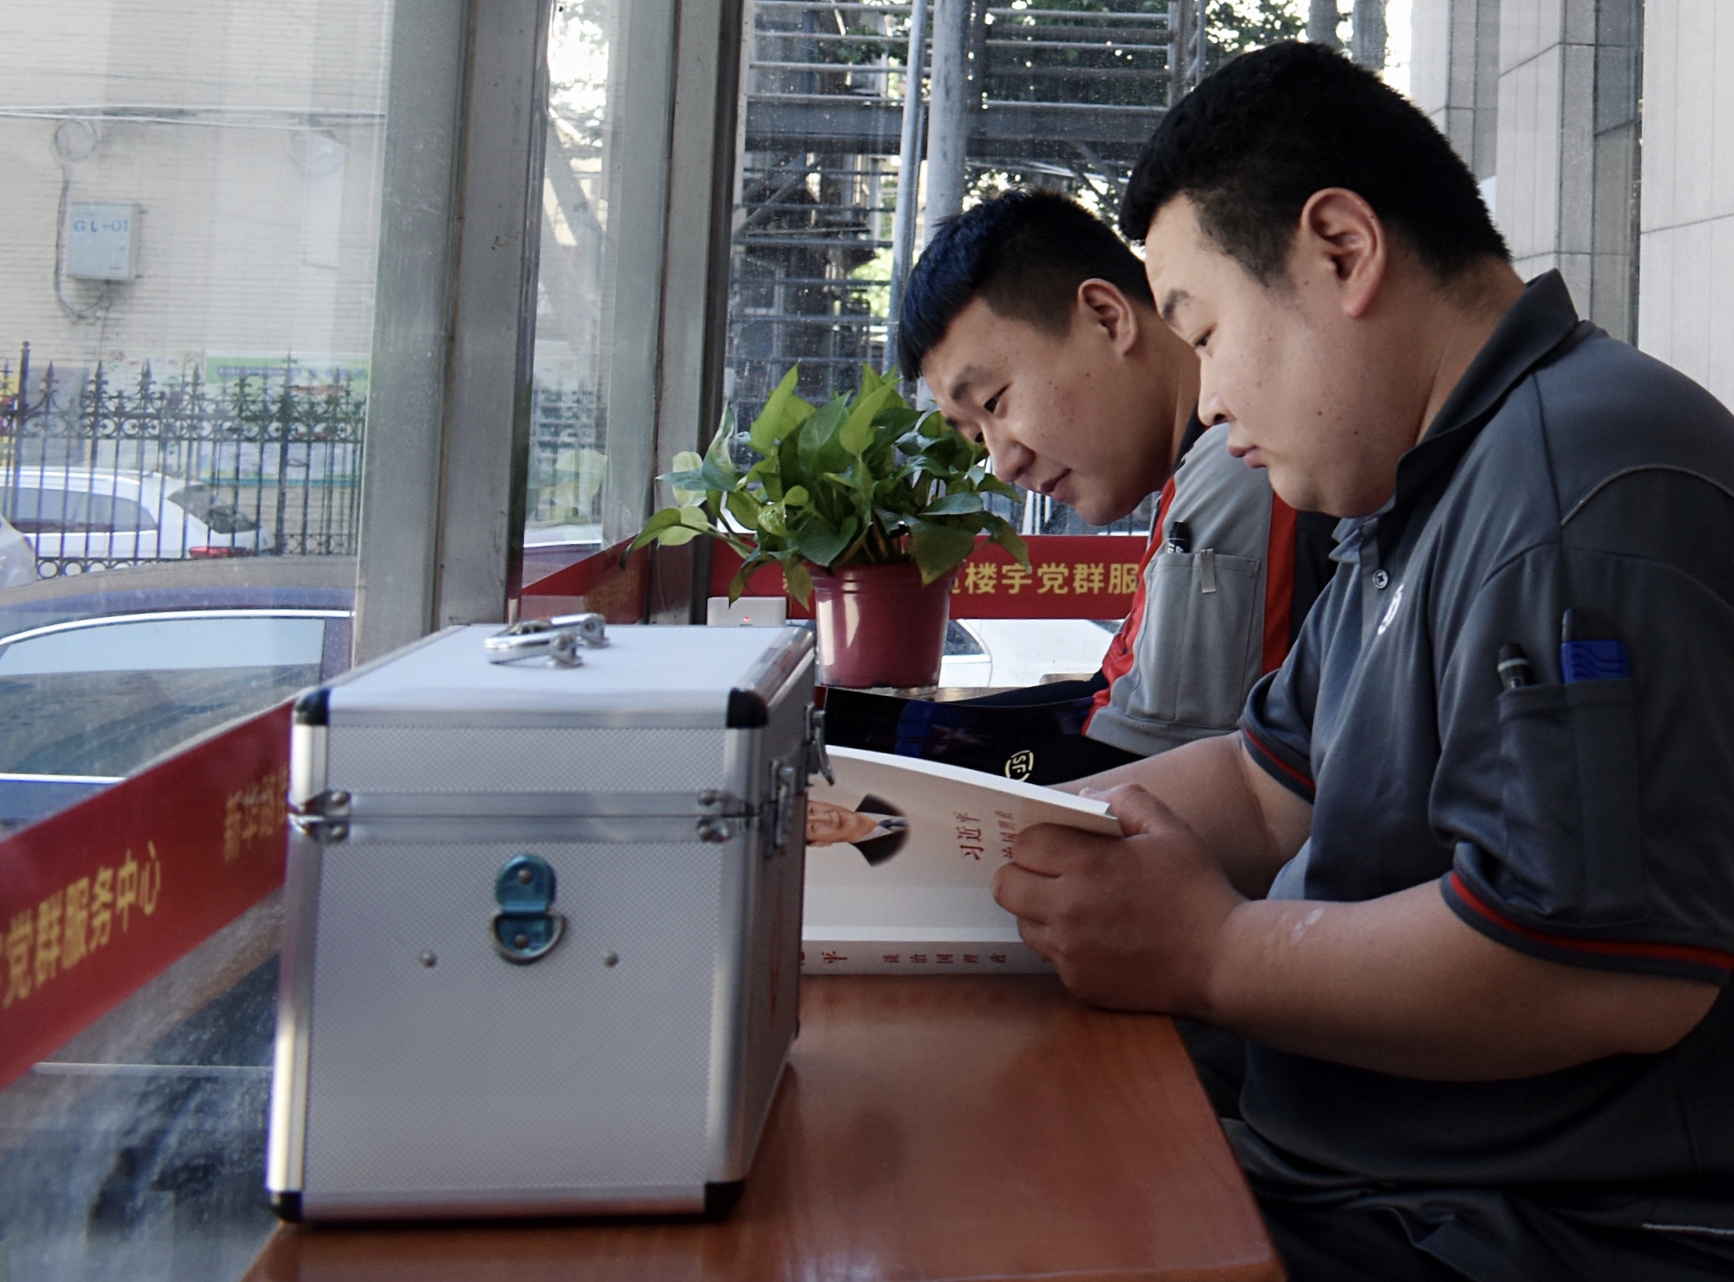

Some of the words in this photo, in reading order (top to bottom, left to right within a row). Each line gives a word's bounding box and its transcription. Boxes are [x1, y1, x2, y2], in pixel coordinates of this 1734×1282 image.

[951, 563, 1140, 595] 楼宇党群服
[952, 810, 985, 861] 习近平
[0, 840, 161, 1008] 党群服务中心
